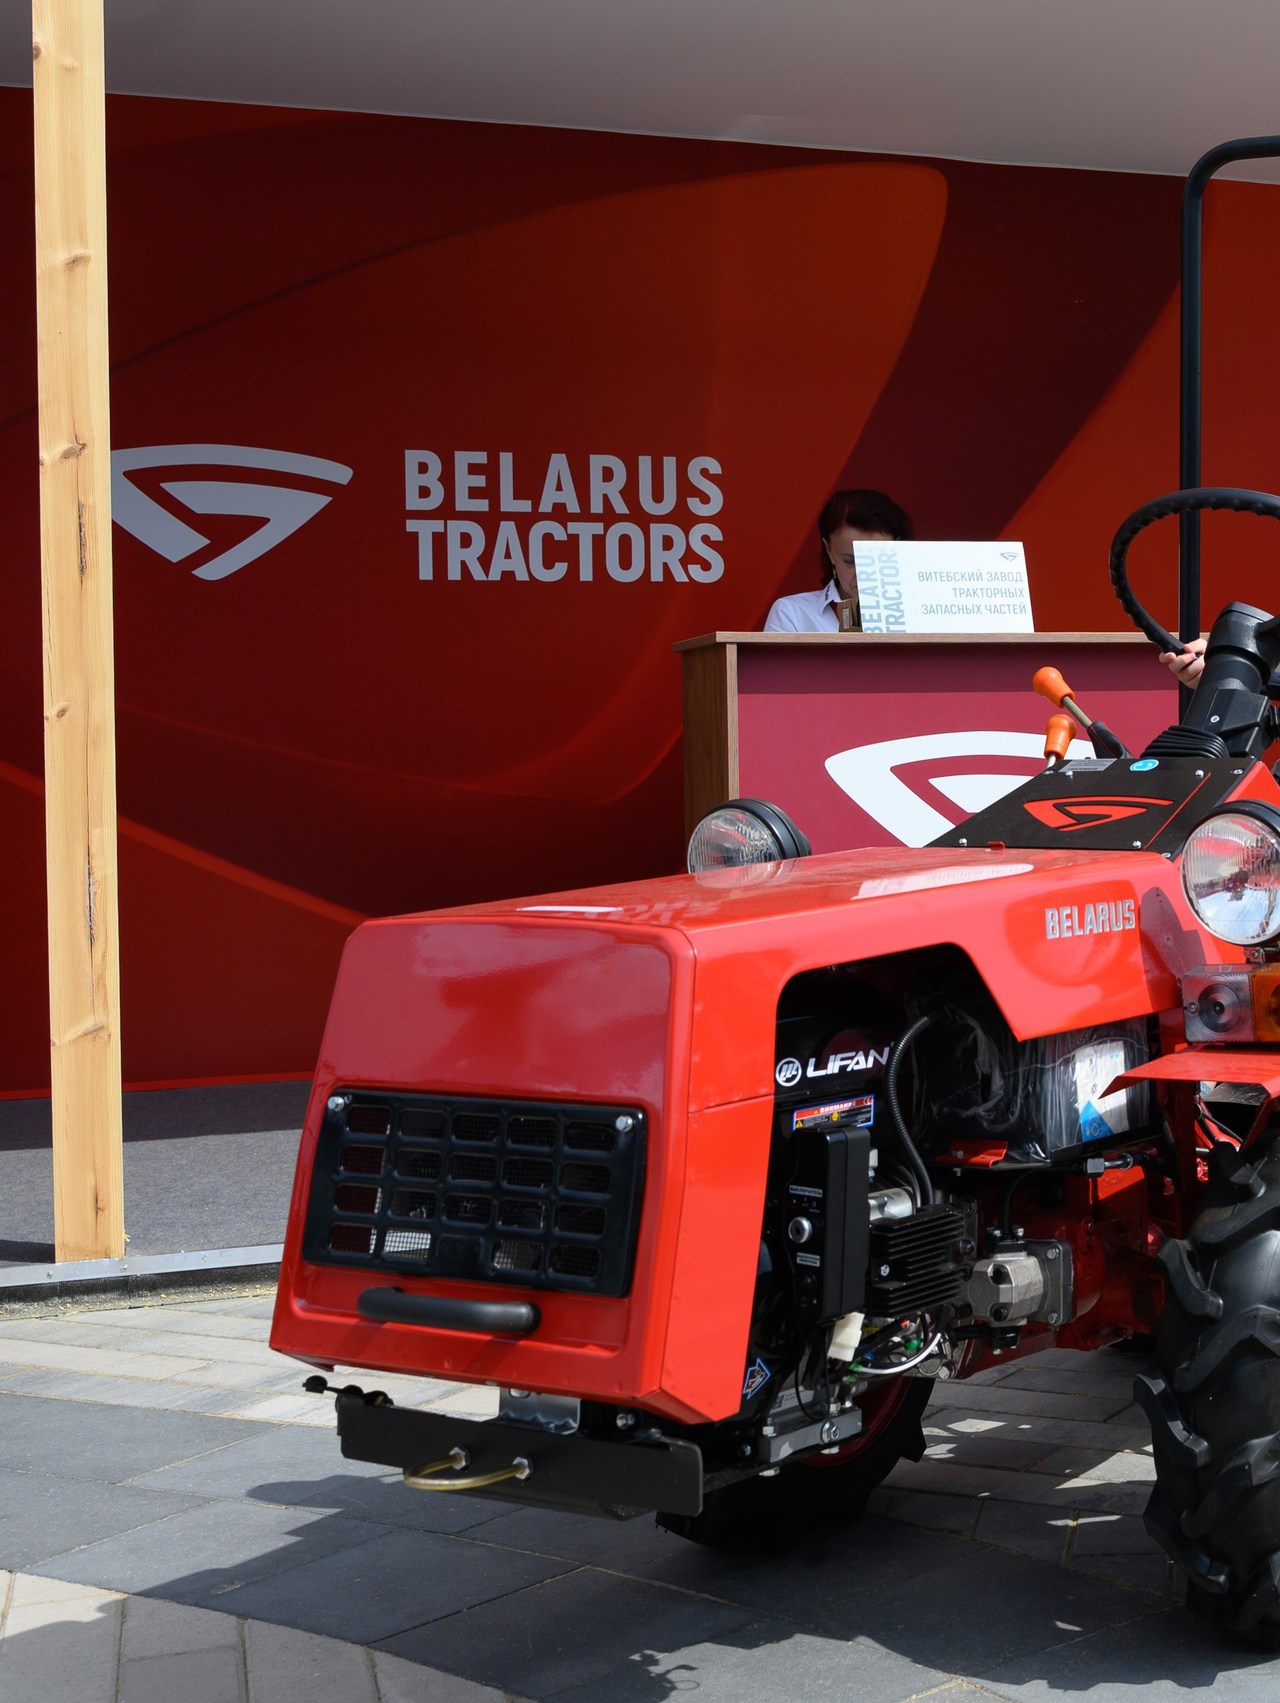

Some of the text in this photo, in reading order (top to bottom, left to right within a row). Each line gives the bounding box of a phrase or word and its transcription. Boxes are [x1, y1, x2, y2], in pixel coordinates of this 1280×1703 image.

[405, 449, 724, 517] BELARUS
[406, 519, 725, 583] TRACTORS
[856, 544, 883, 633] BELARU
[878, 544, 907, 633] TRACTOR
[917, 569, 1024, 583] ВИТЕБСКИЙ ЗАВОД
[952, 587, 1025, 599] ТРАКТОРНЫХ
[921, 601, 1027, 615] ЗАПАСНЫХ ЧАСТЕЙ
[1045, 899, 1136, 940] BELARUS
[806, 1047, 890, 1078] LIFAN
